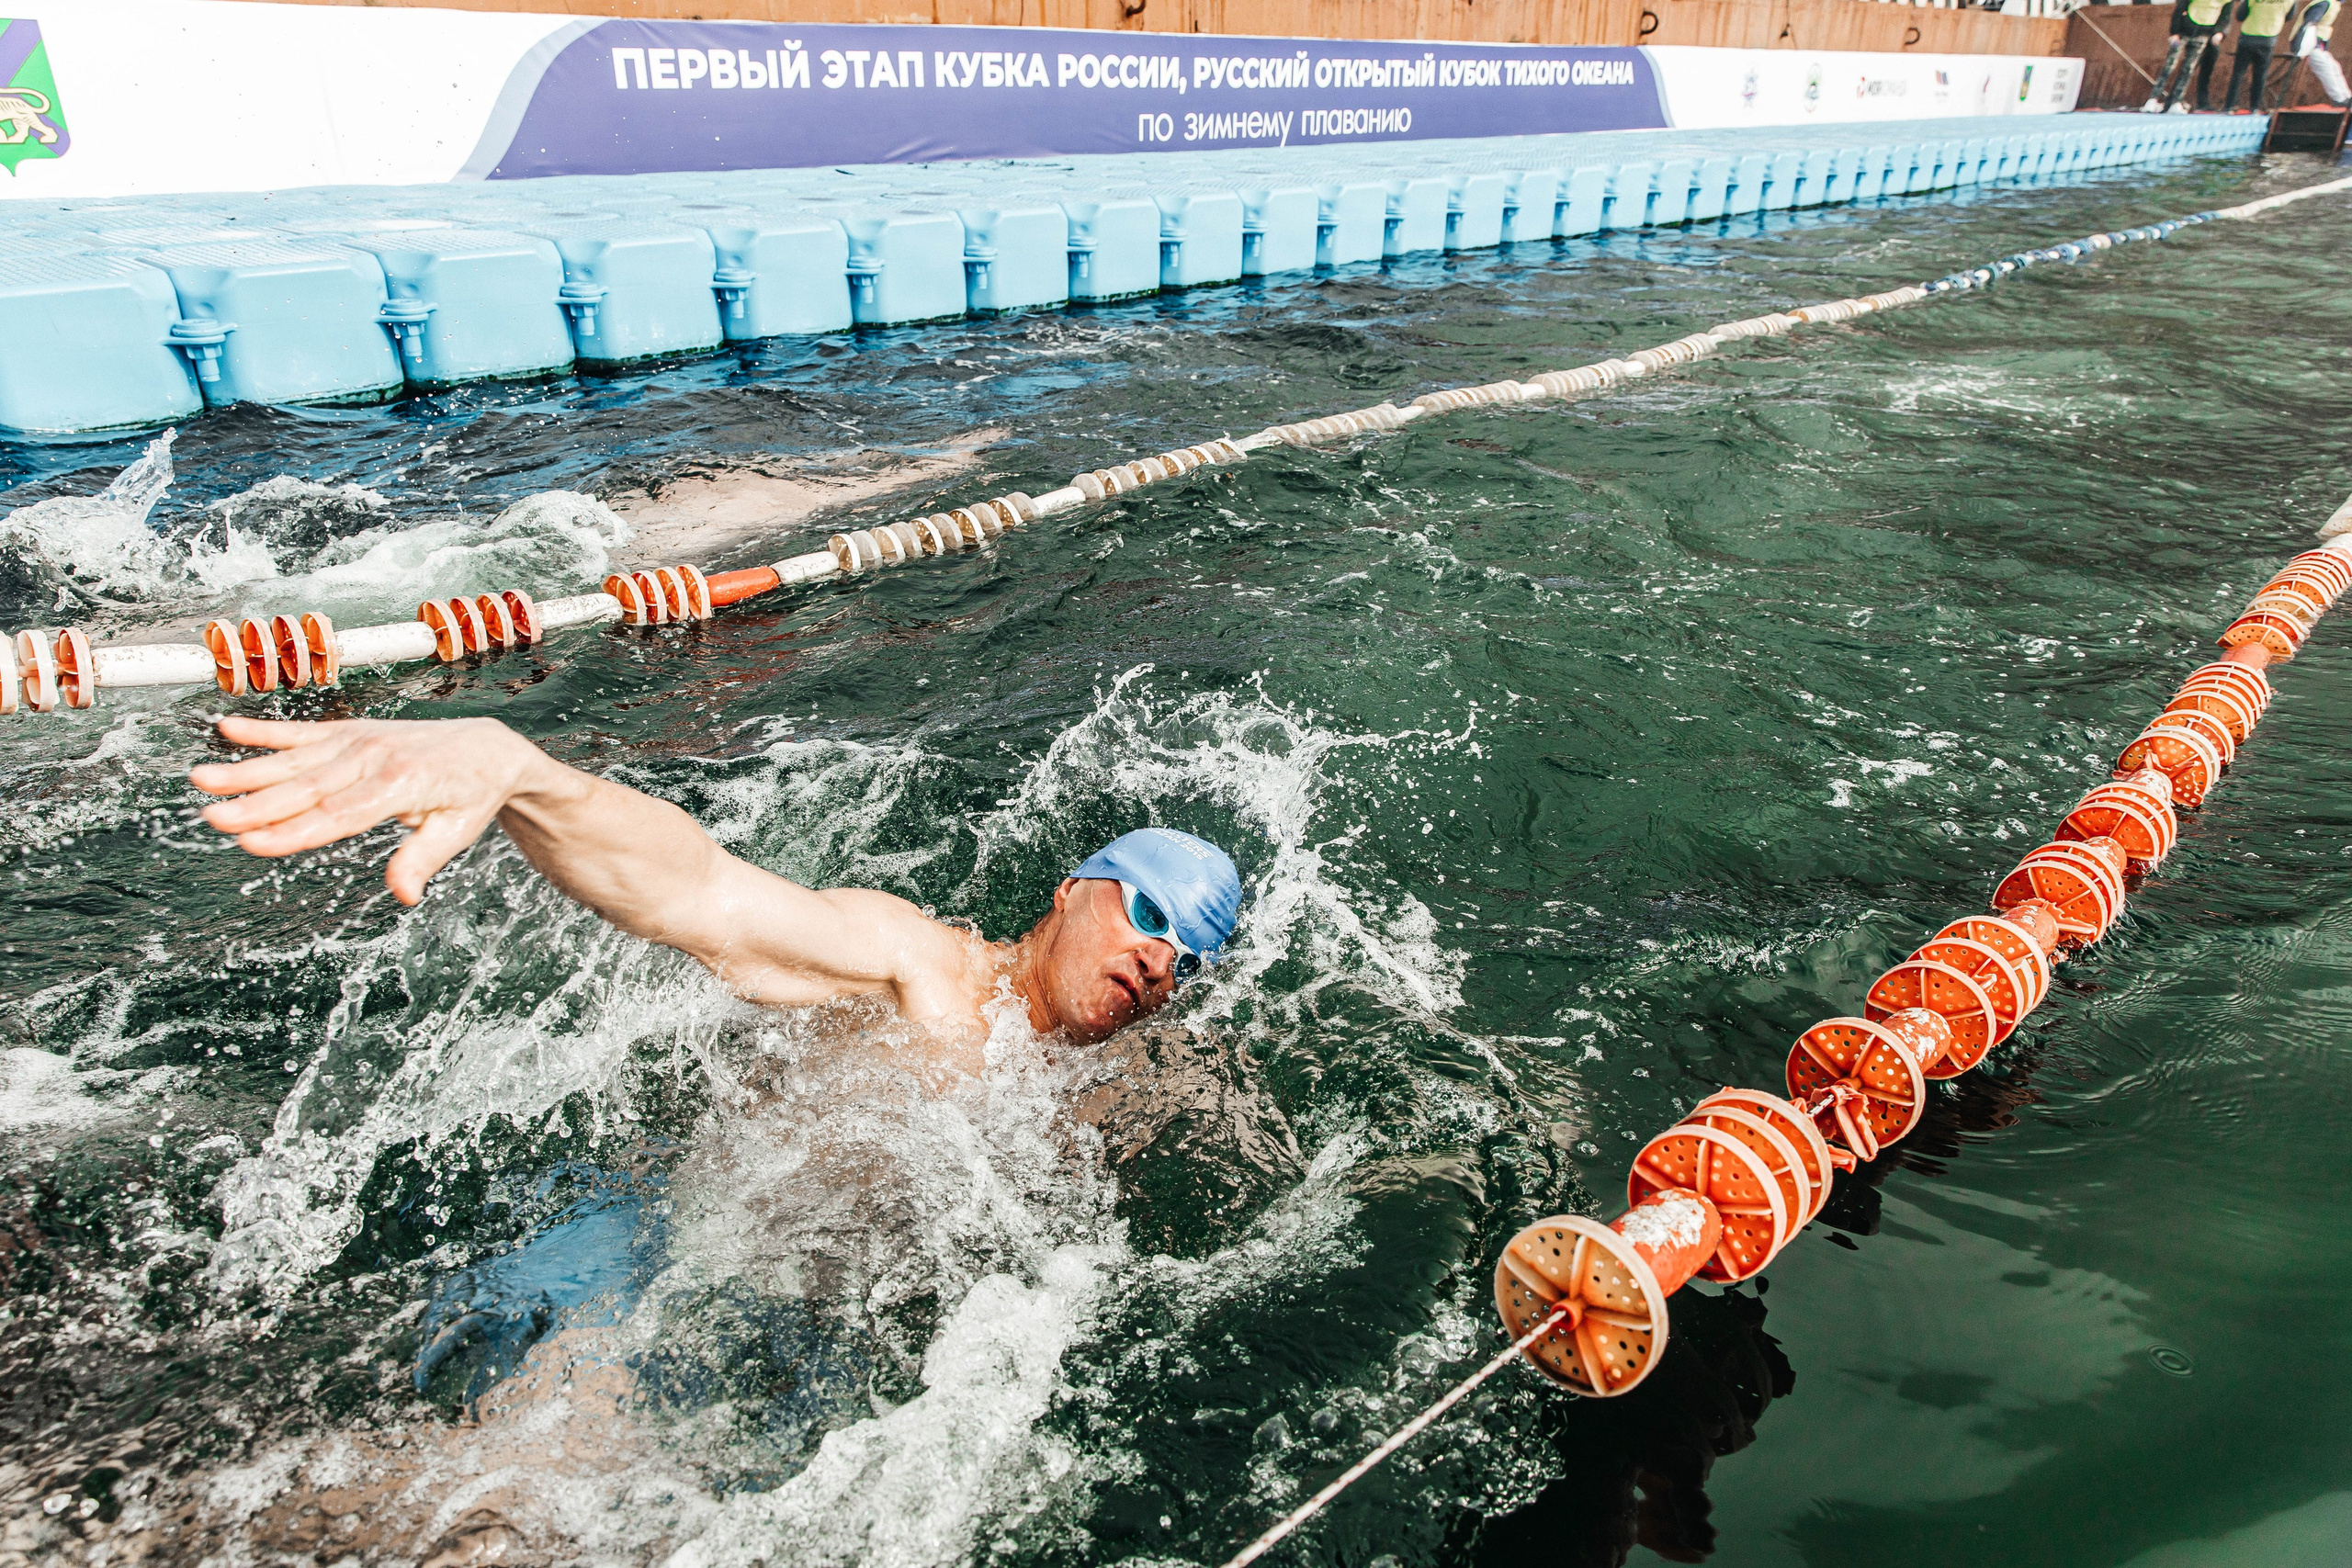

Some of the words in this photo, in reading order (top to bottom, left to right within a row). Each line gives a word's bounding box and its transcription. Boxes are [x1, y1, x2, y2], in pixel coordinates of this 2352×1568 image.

[611, 39, 811, 90] ПЕРВЫЙ
[820, 49, 925, 90] ЭТАП
[933, 50, 1052, 89] КУБКА
[1057, 53, 1189, 95] РОССИИ,
[1193, 50, 1310, 89] РУССКИЙ
[1314, 52, 1437, 89] ОТКРЫТЫЙ
[1438, 59, 1503, 88] КУБОК
[1504, 59, 1571, 87] ТИХОГО
[1570, 60, 1635, 86] ОКЕАНА
[1182, 109, 1294, 148] зимнему
[1301, 107, 1413, 138] плаванию
[1180, 842, 1204, 861] 2015
